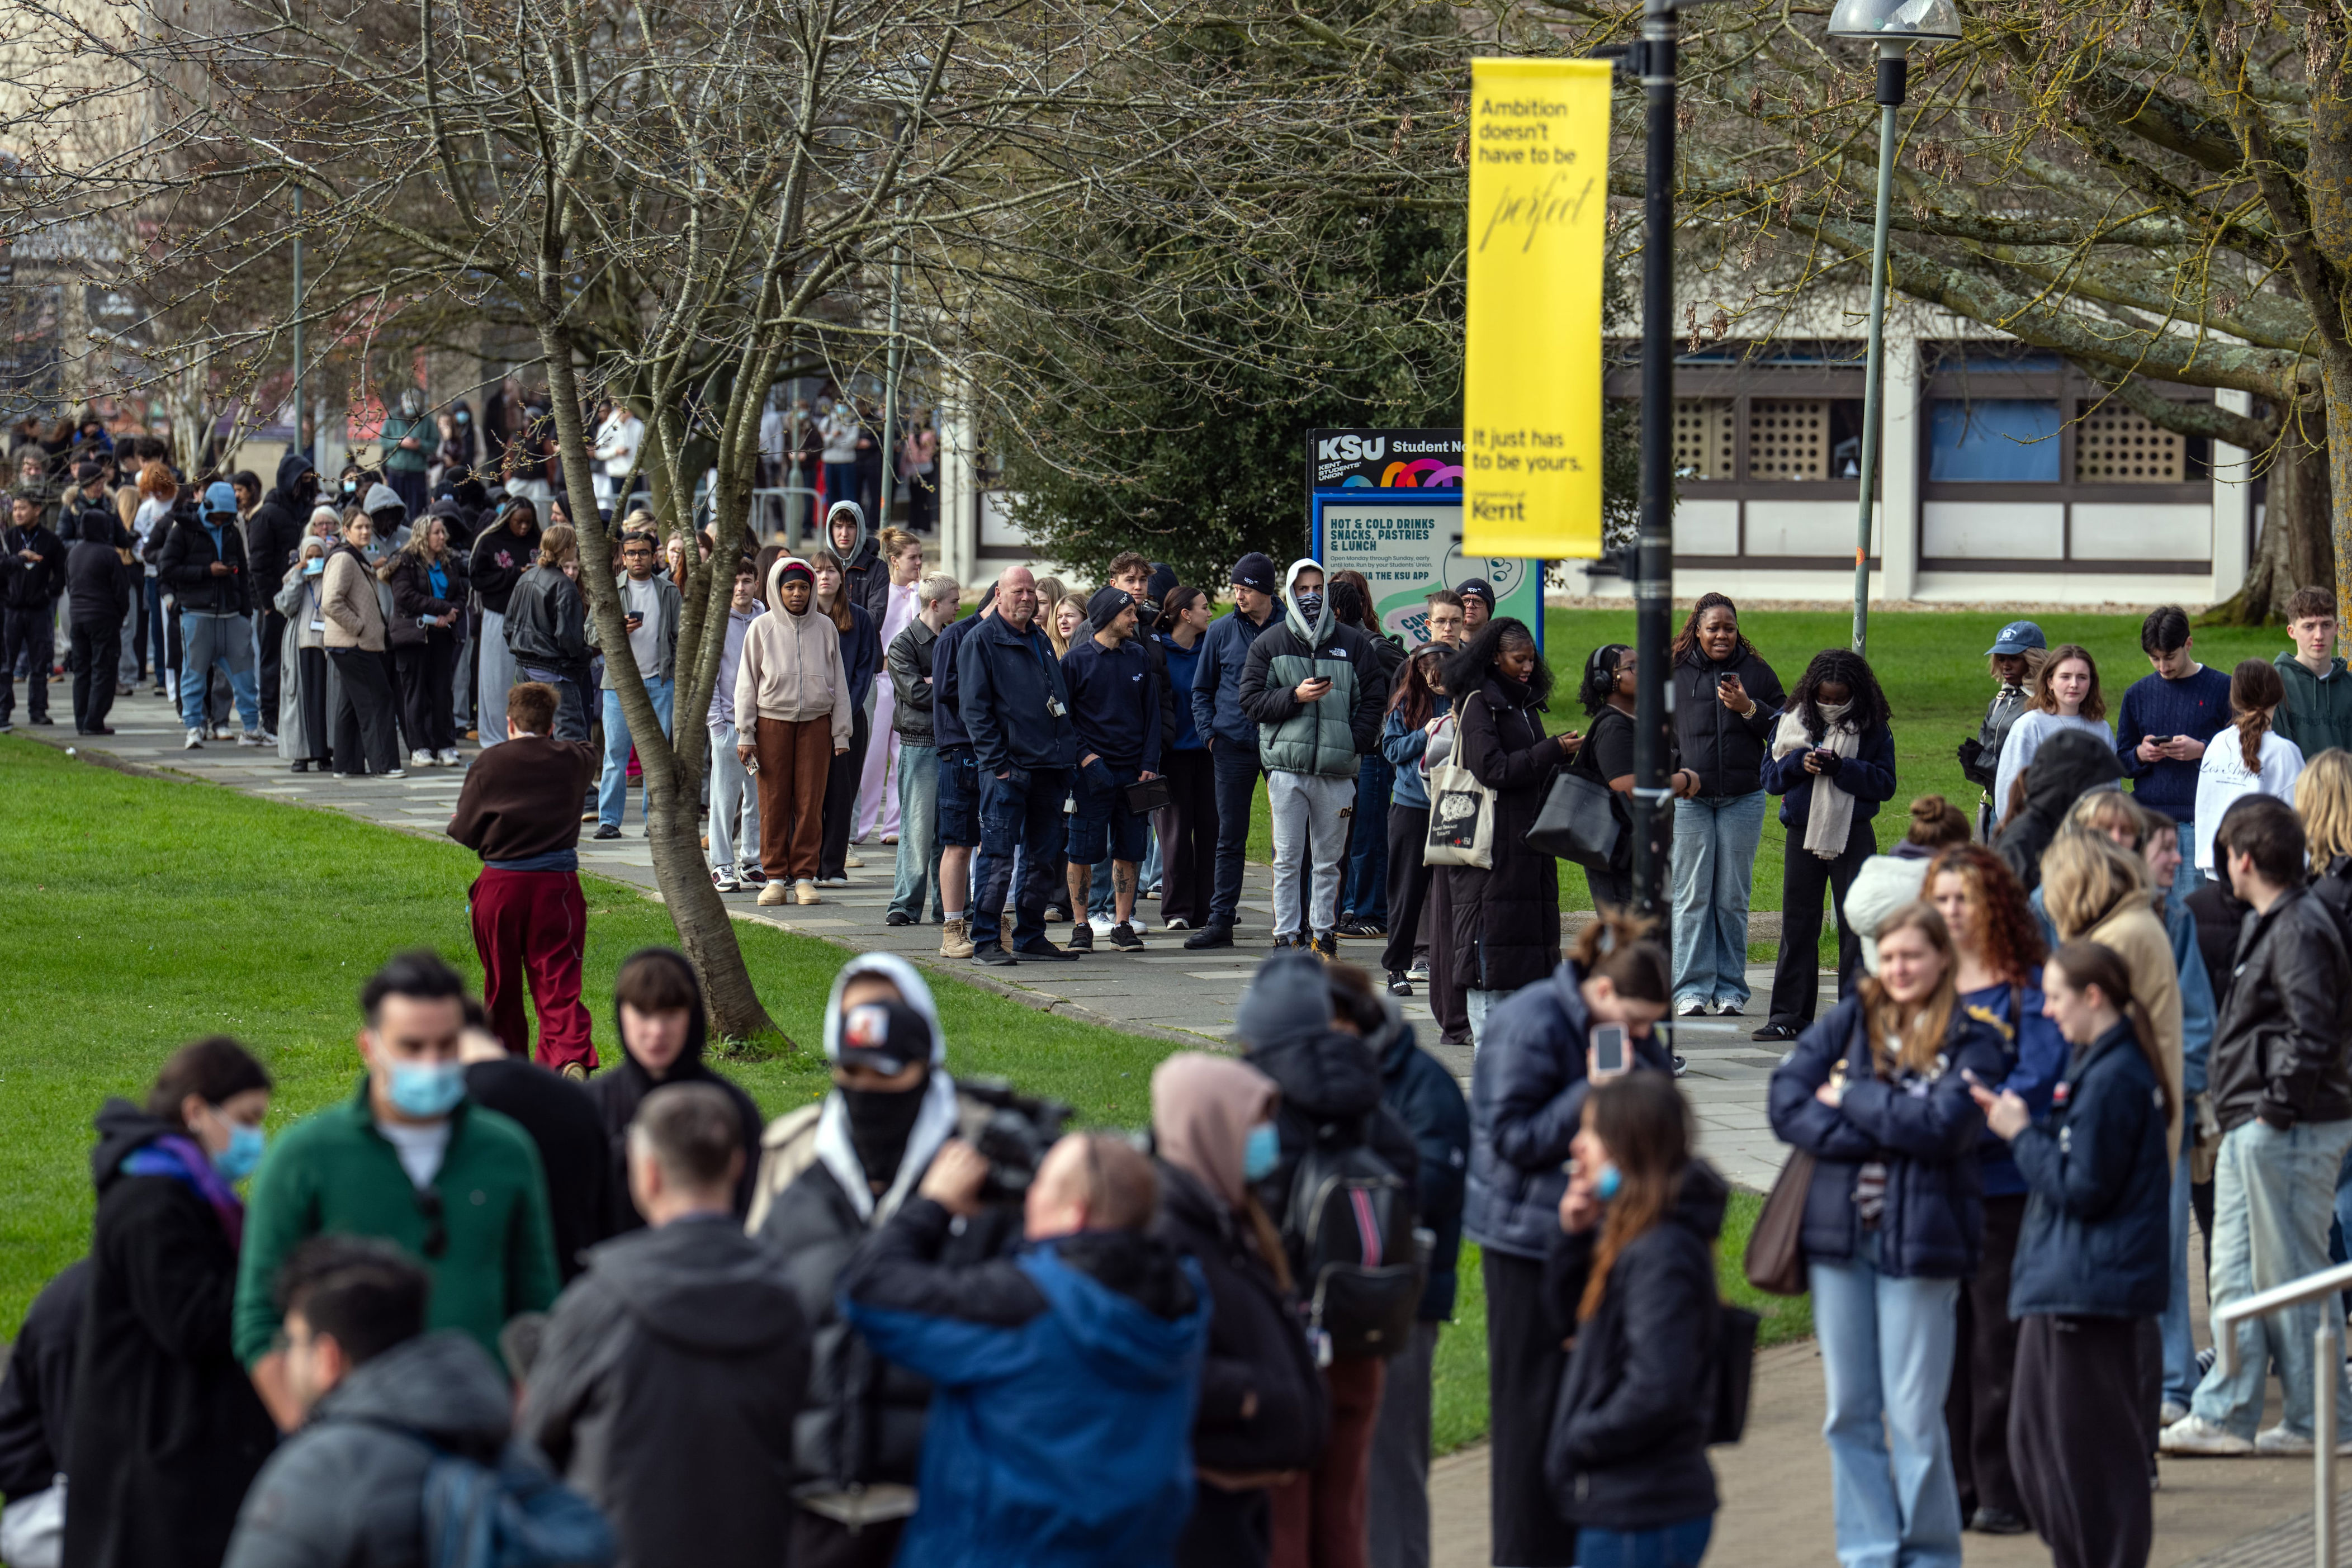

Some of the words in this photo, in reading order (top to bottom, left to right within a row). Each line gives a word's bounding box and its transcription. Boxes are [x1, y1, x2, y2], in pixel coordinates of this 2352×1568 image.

[1479, 99, 1568, 117] Ambition
[1479, 122, 1548, 140] doesn't
[1479, 146, 1524, 164] have
[1531, 148, 1549, 164] to
[1554, 146, 1576, 164] be
[1478, 170, 1594, 254] perfect
[1392, 440, 1449, 452] Student
[1472, 429, 1485, 447] It
[1490, 428, 1526, 449] just
[1531, 429, 1564, 447] has
[1319, 435, 1385, 461] KSU
[1318, 462, 1361, 476] STUDENTS'
[1319, 461, 1341, 471] KENT
[1472, 453, 1491, 470] to
[1497, 453, 1520, 471] be
[1526, 456, 1583, 473] yours.
[1318, 471, 1343, 481] UNION
[1473, 500, 1525, 521] Kent
[1331, 519, 1351, 529] HOT
[1355, 519, 1362, 529] &
[1366, 519, 1393, 529] COLD
[1397, 519, 1435, 529] DRINKS
[1331, 530, 1374, 541] SNACKS,
[1378, 530, 1429, 540] PASTRIES
[1331, 541, 1338, 551] &
[1342, 541, 1376, 551] LUNCH
[2200, 760, 2218, 773] Los
